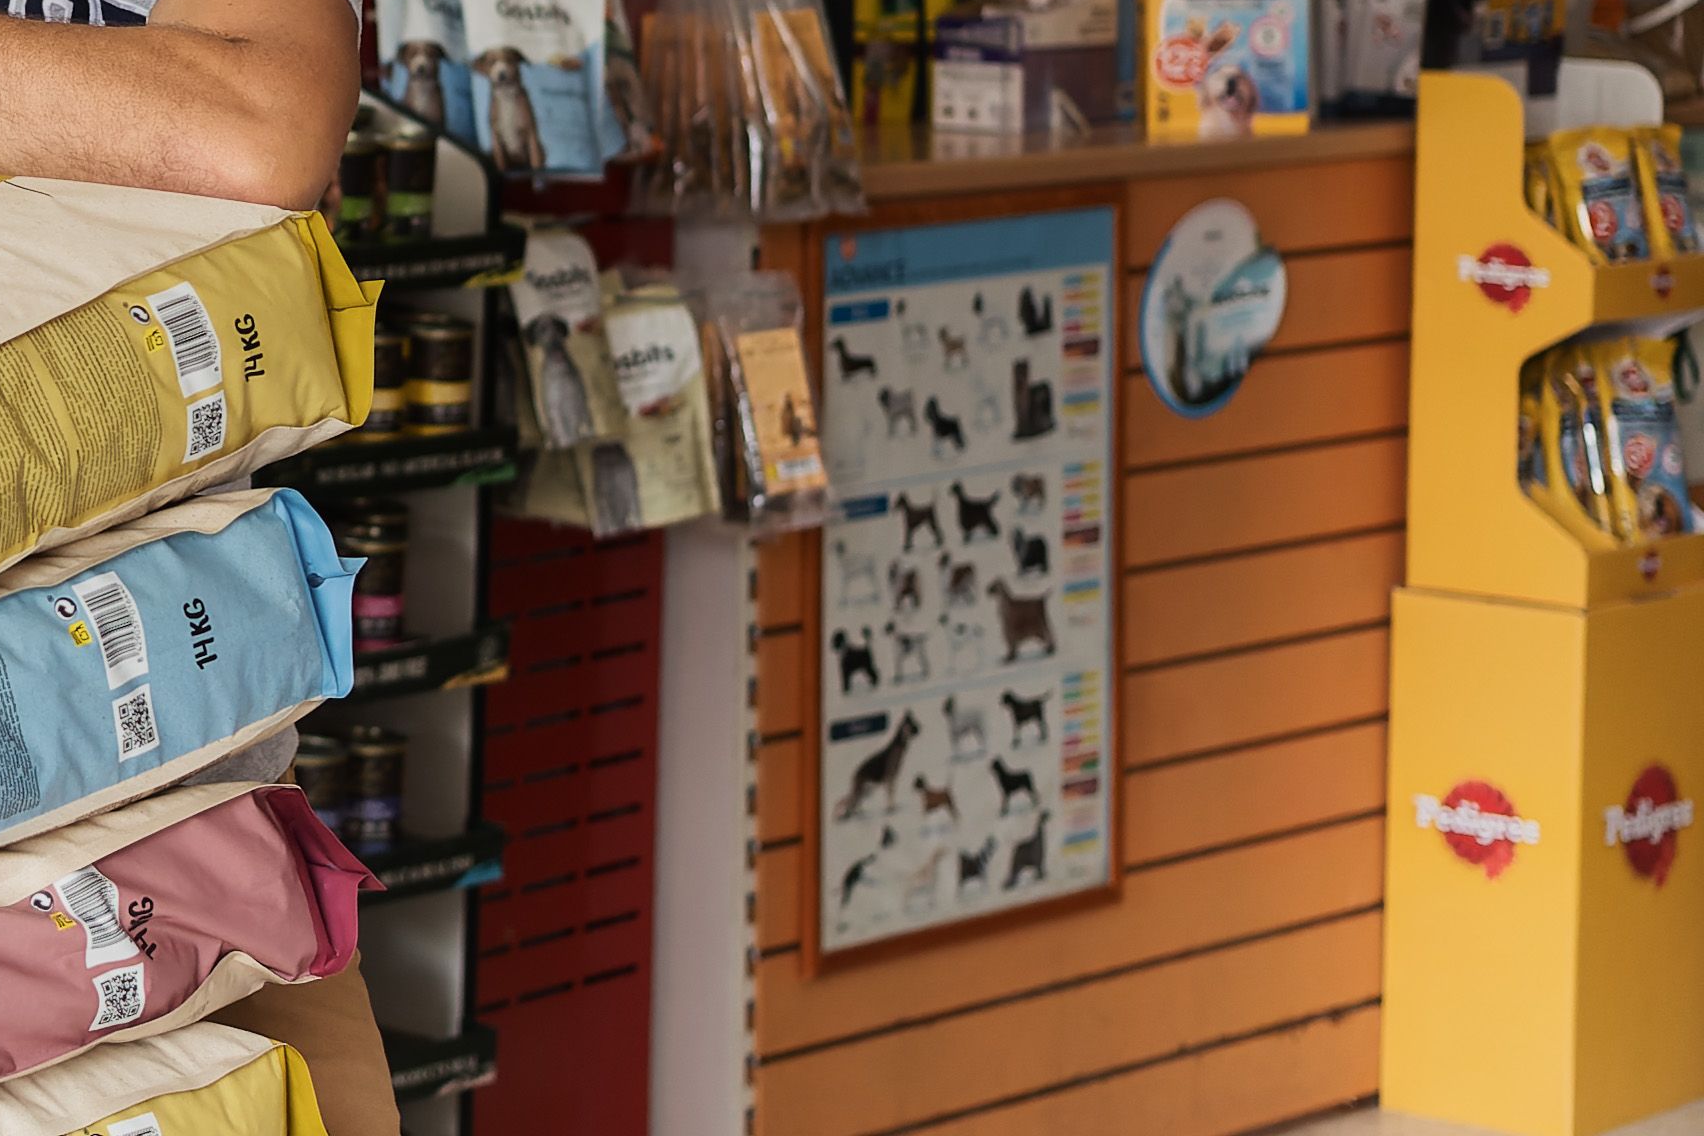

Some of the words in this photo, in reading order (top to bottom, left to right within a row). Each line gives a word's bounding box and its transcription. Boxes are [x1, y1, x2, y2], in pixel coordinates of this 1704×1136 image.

[234, 313, 260, 351] KG
[244, 353, 265, 383] 14
[184, 598, 211, 636] KG
[193, 637, 218, 670] 14
